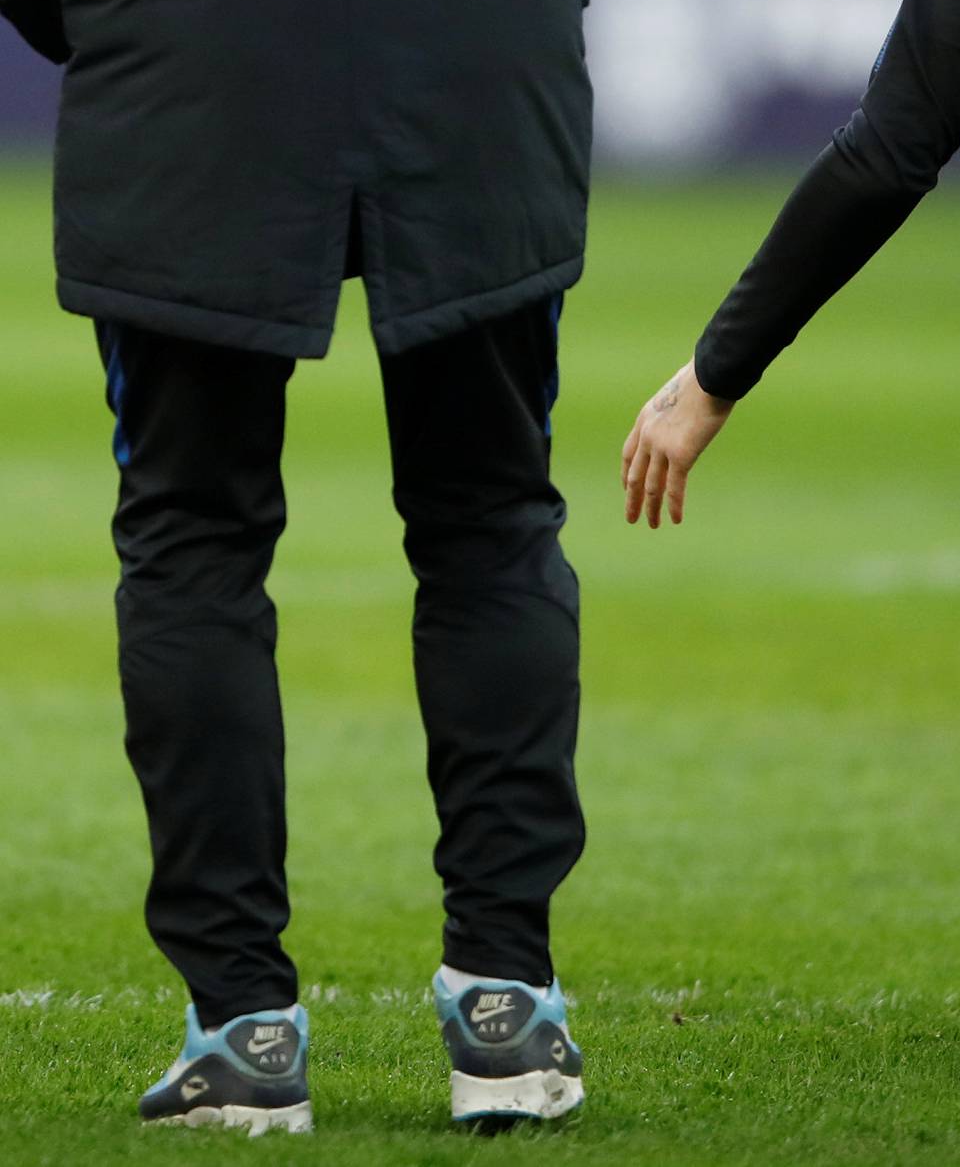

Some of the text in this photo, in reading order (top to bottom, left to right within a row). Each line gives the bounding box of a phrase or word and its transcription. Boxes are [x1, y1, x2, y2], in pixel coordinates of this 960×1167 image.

[478, 993, 513, 1009] NIKE
[254, 1025, 286, 1041] NIKE
[478, 1022, 508, 1033] AIR
